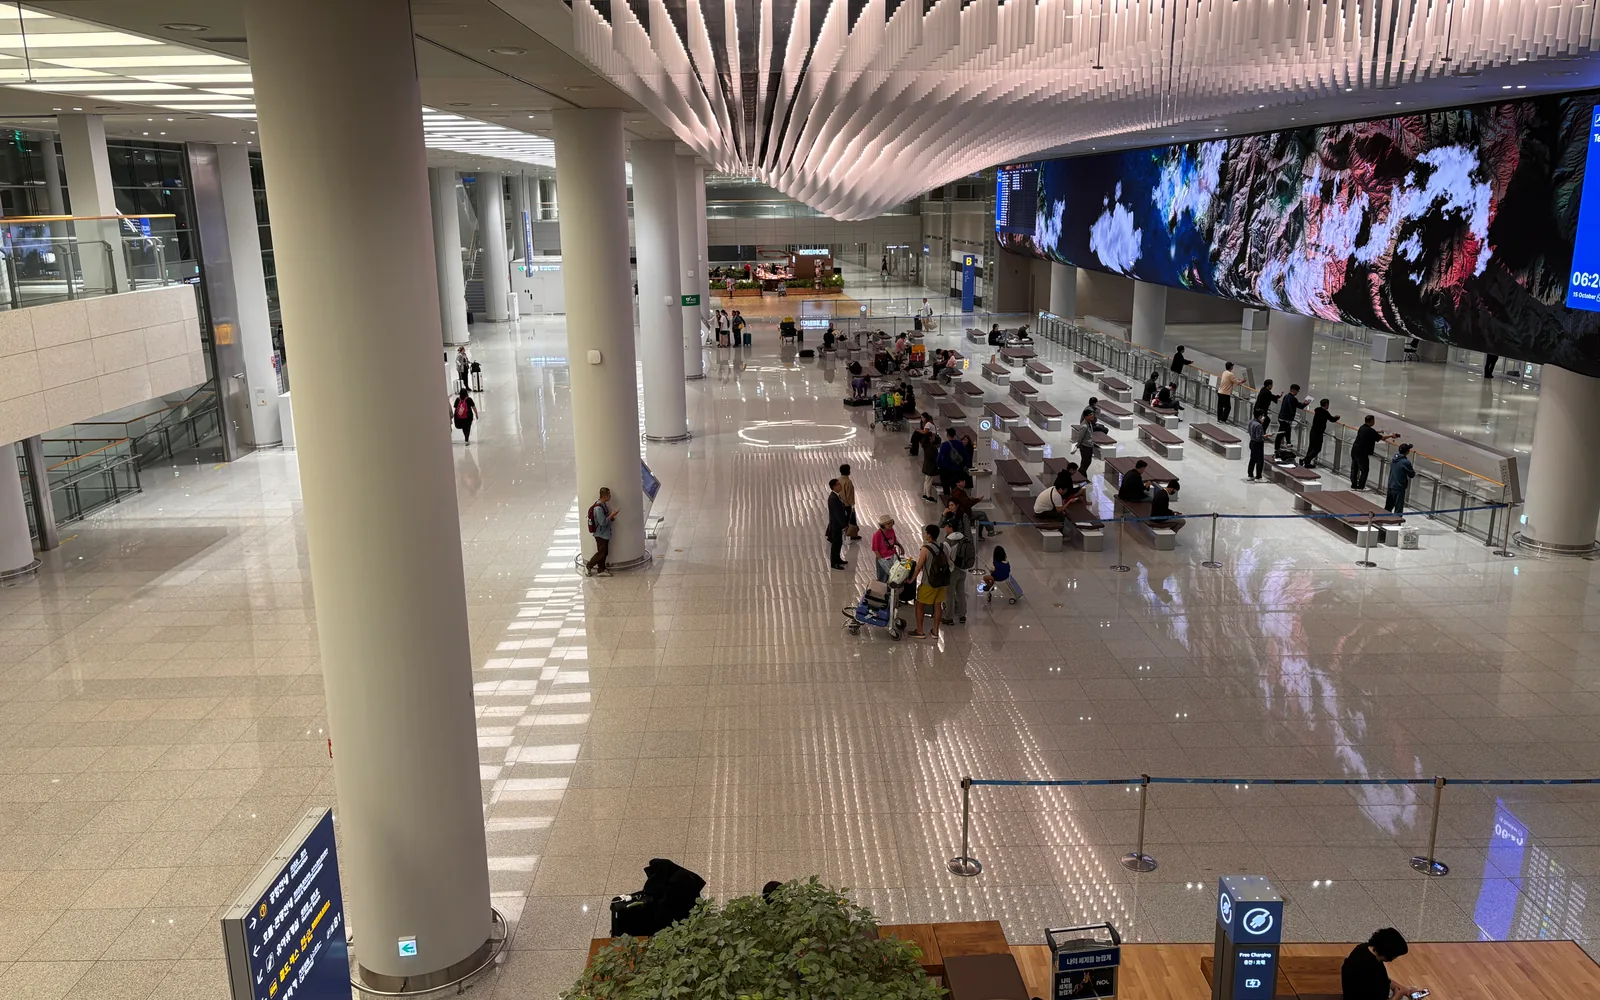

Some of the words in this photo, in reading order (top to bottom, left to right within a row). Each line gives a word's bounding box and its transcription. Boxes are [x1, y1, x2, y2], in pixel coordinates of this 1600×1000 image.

[966, 257, 973, 266] B
[1572, 271, 1600, 288] 06:2
[1578, 292, 1596, 300] October
